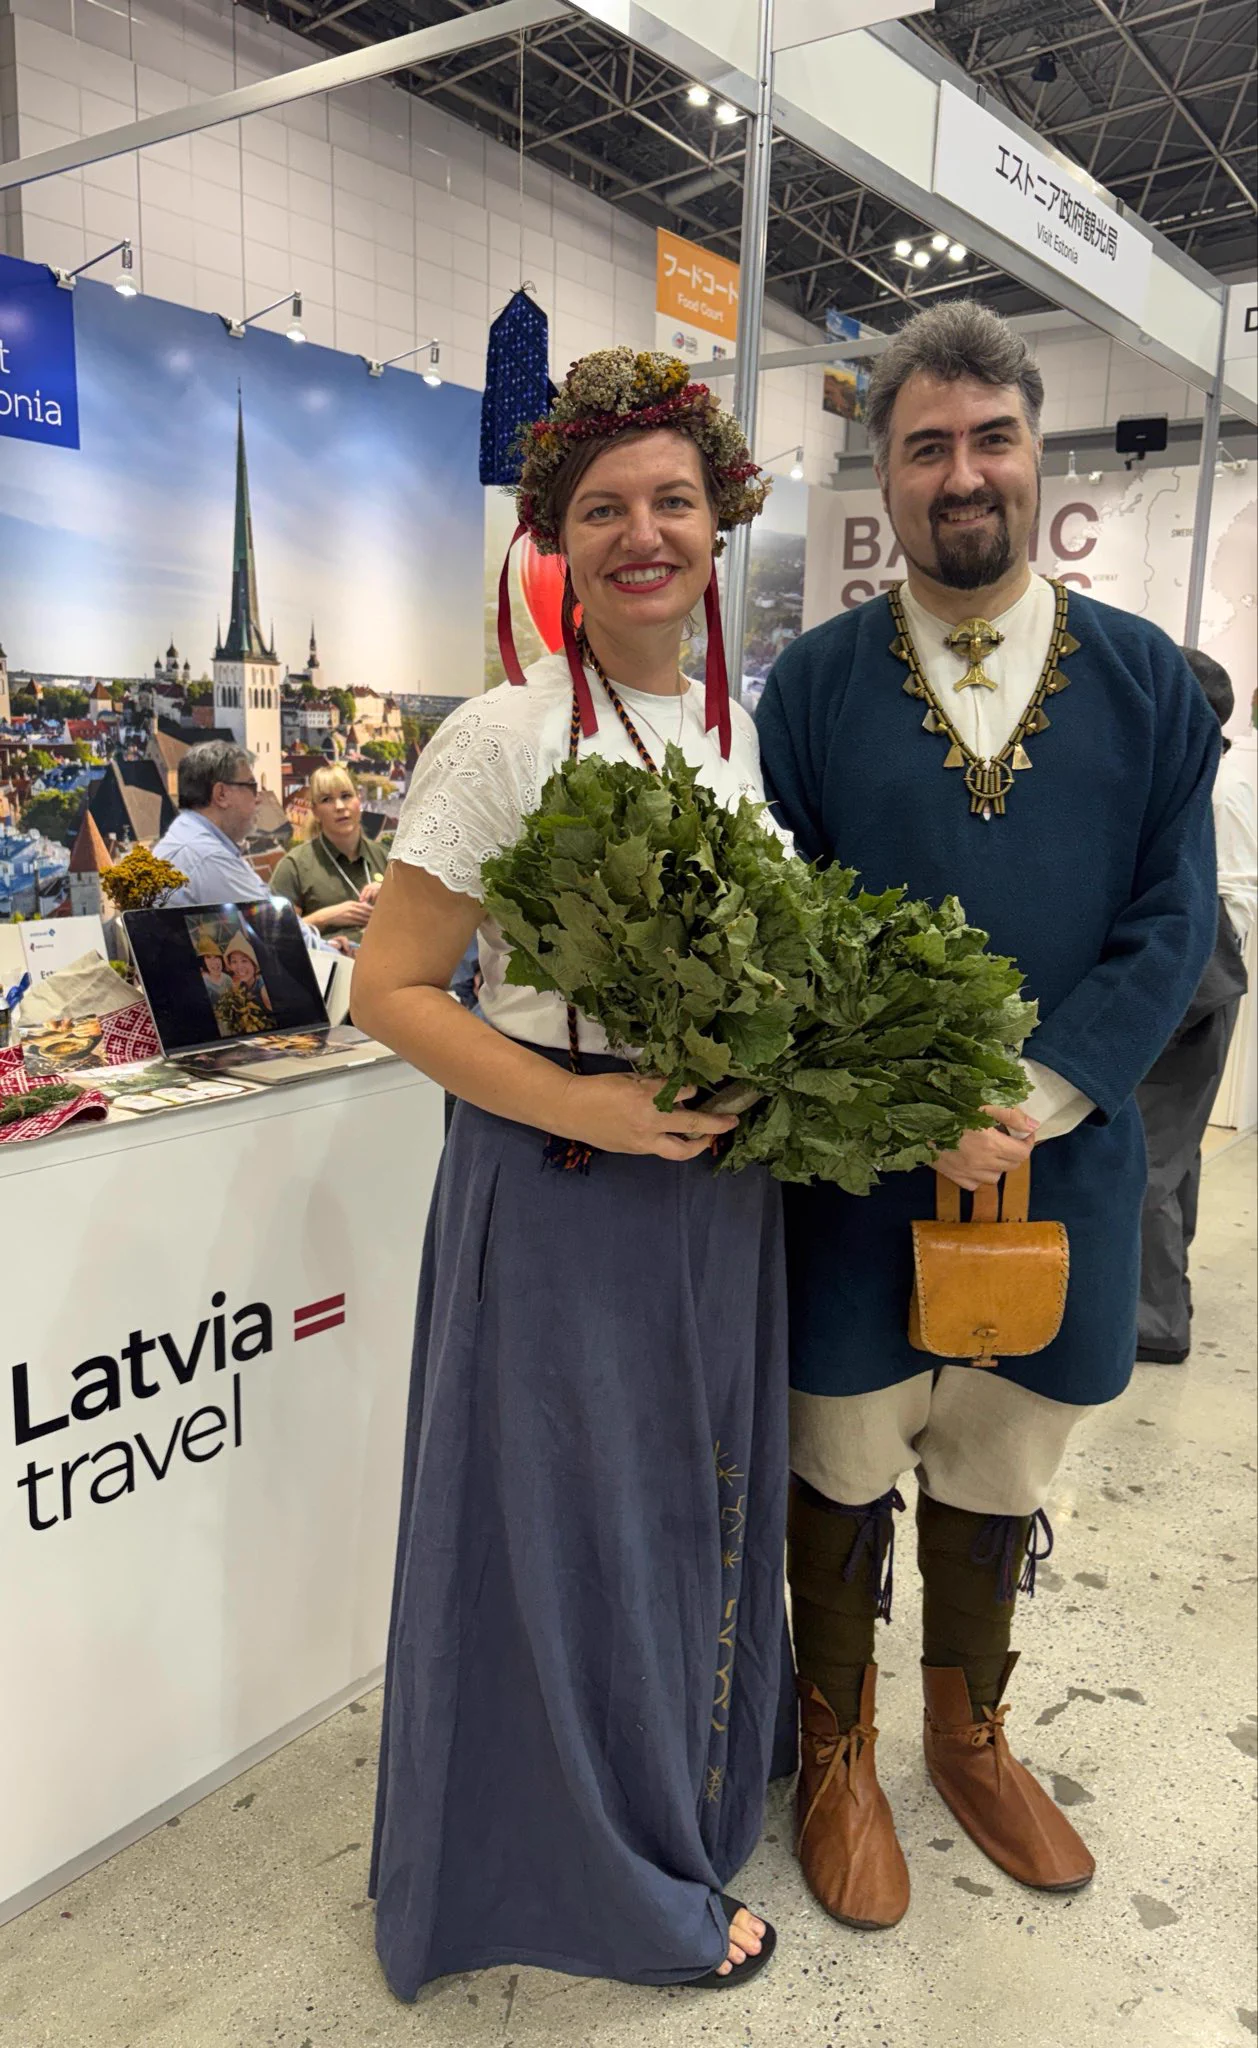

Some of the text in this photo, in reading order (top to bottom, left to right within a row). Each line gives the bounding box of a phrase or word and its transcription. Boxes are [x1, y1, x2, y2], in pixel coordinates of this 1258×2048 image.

[995, 145, 1118, 261] エストニア政府観光局
[1037, 221, 1079, 264] Visit Estonia
[663, 252, 739, 305] フードコート
[677, 292, 724, 322] Food Court
[1171, 528, 1194, 538] SWEDE
[11, 1290, 273, 1446] Latvia
[17, 1372, 242, 1531] travel
